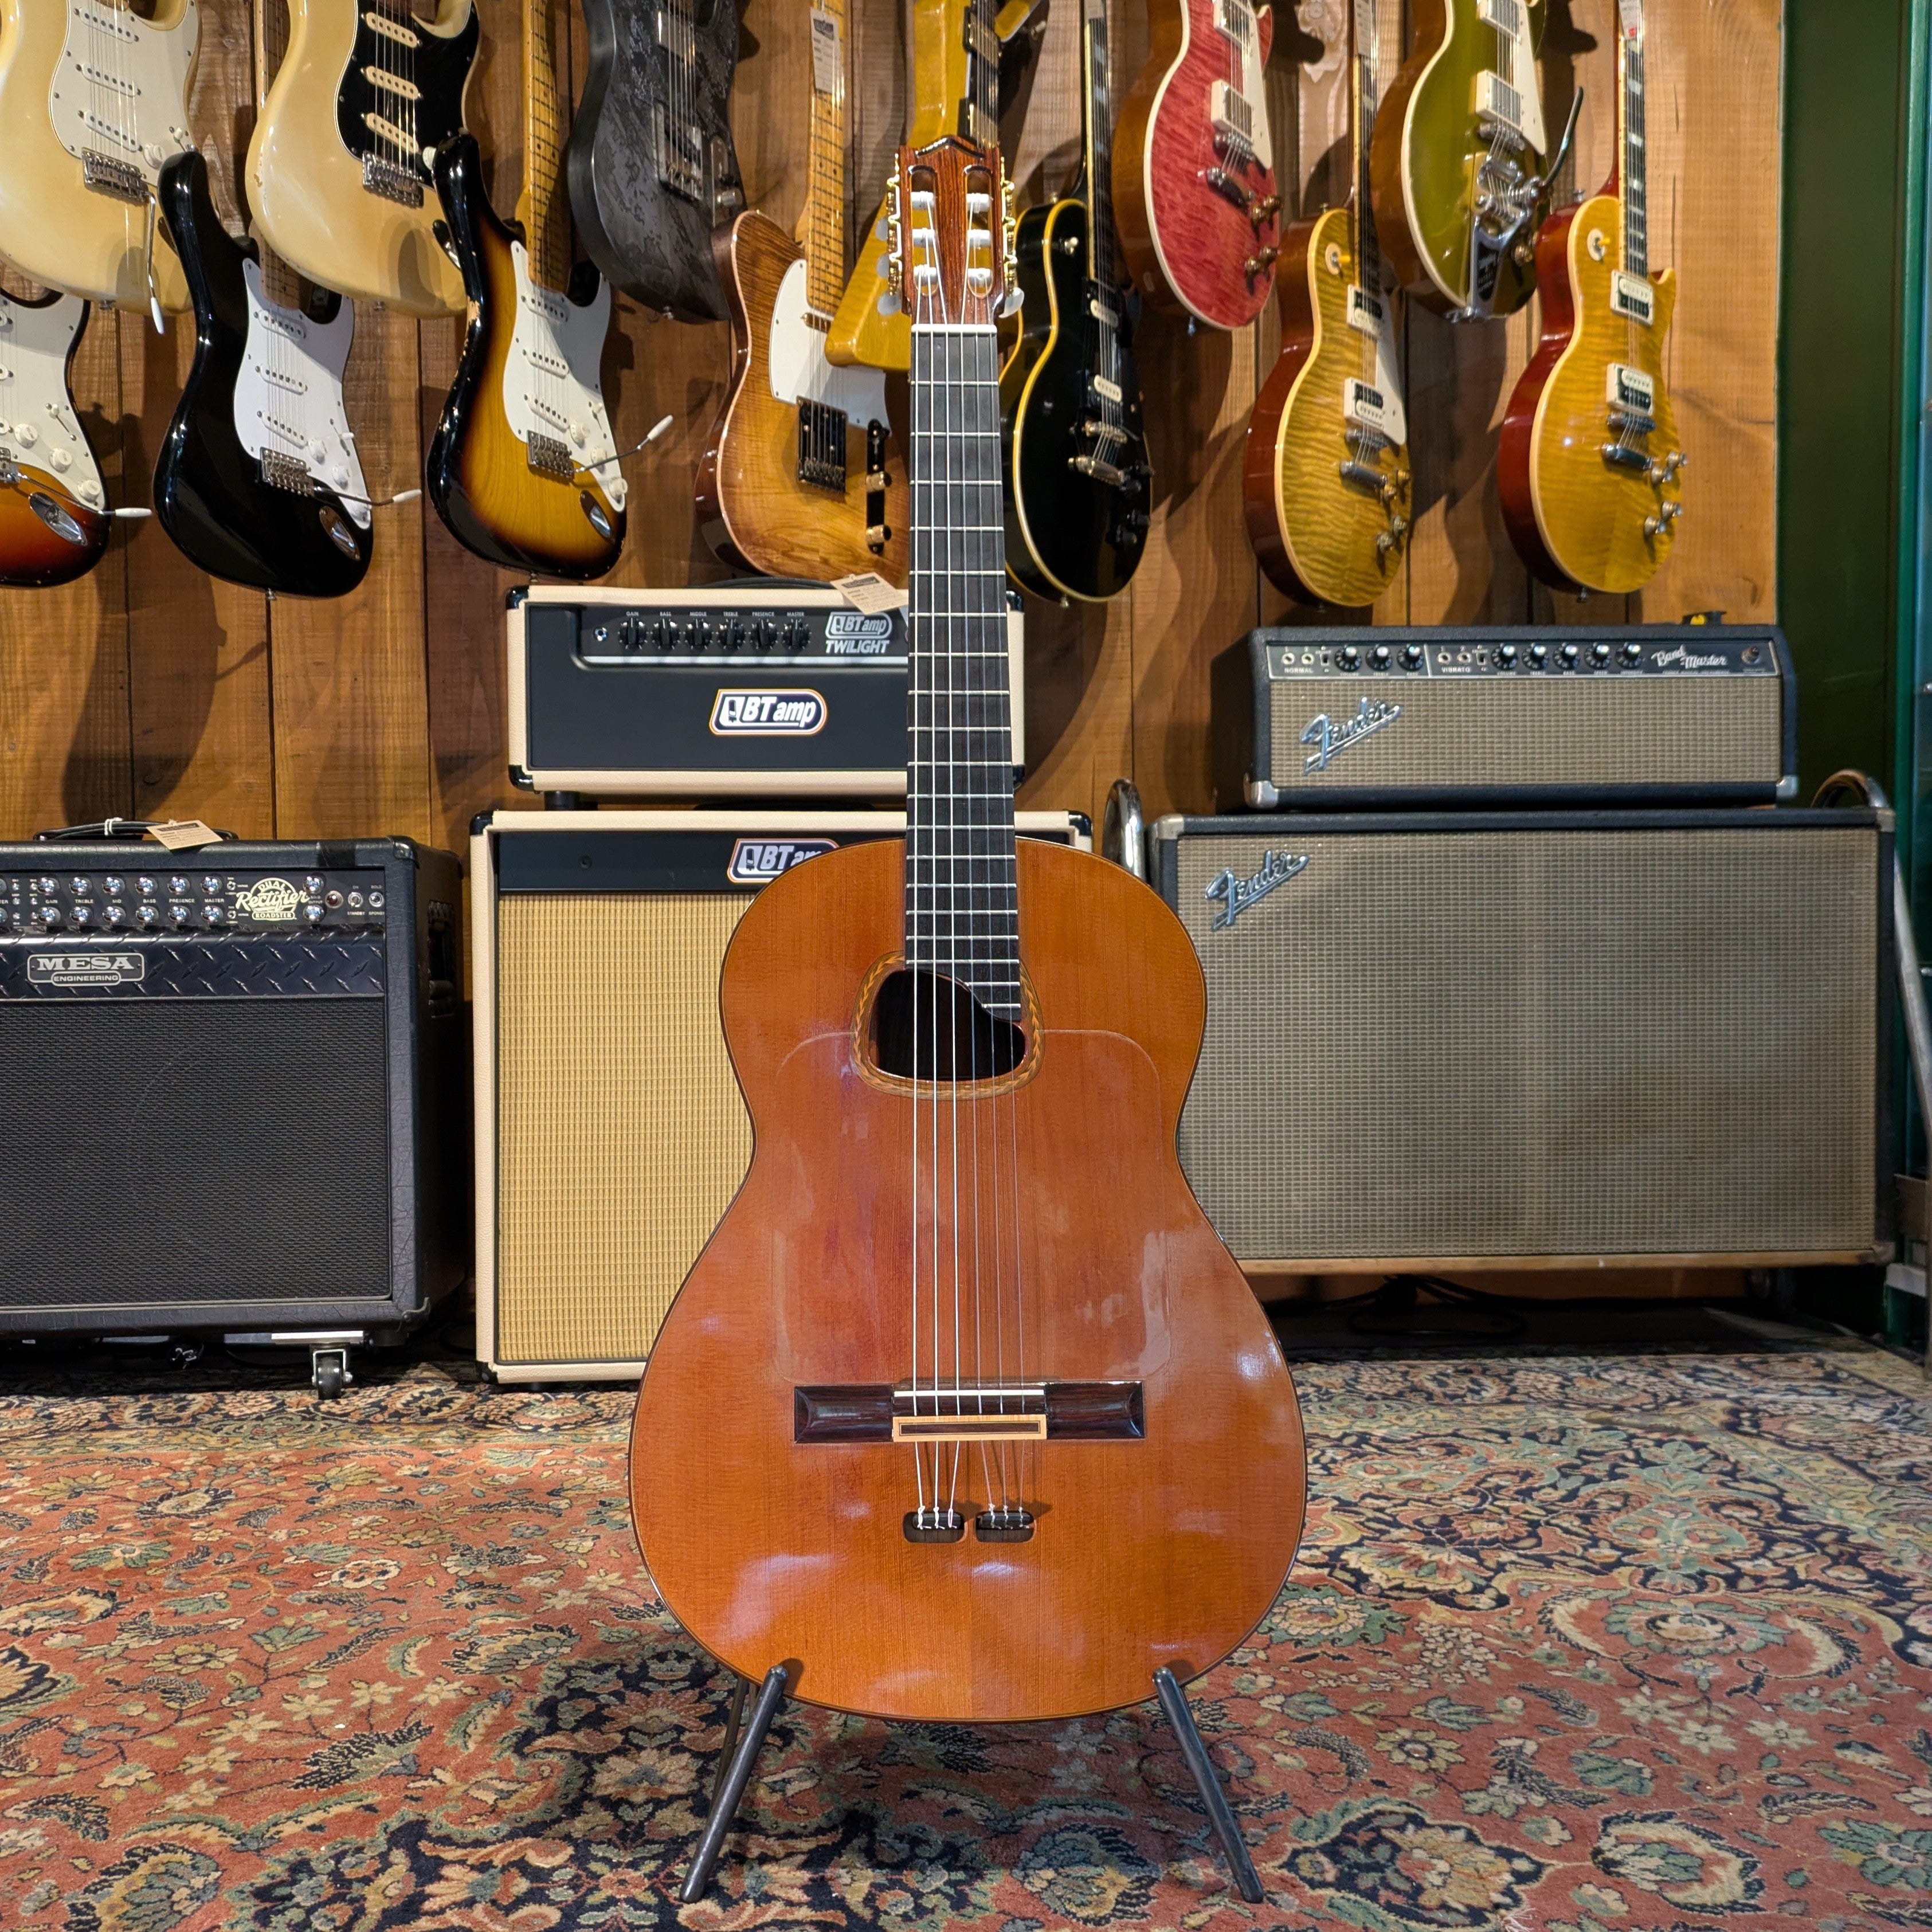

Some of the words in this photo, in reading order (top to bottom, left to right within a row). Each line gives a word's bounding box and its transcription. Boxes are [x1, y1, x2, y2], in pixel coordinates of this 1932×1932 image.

[861, 619, 887, 636] amp
[825, 640, 889, 653] TWILIGHT
[1651, 644, 1686, 667] Band
[1680, 654, 1728, 669] Master
[773, 702, 817, 728] amp
[1299, 696, 1404, 775] Fender
[258, 880, 285, 891] DUAL
[1205, 849, 1309, 931] Fender
[236, 889, 310, 912] Rectifier
[37, 957, 134, 971] MESA
